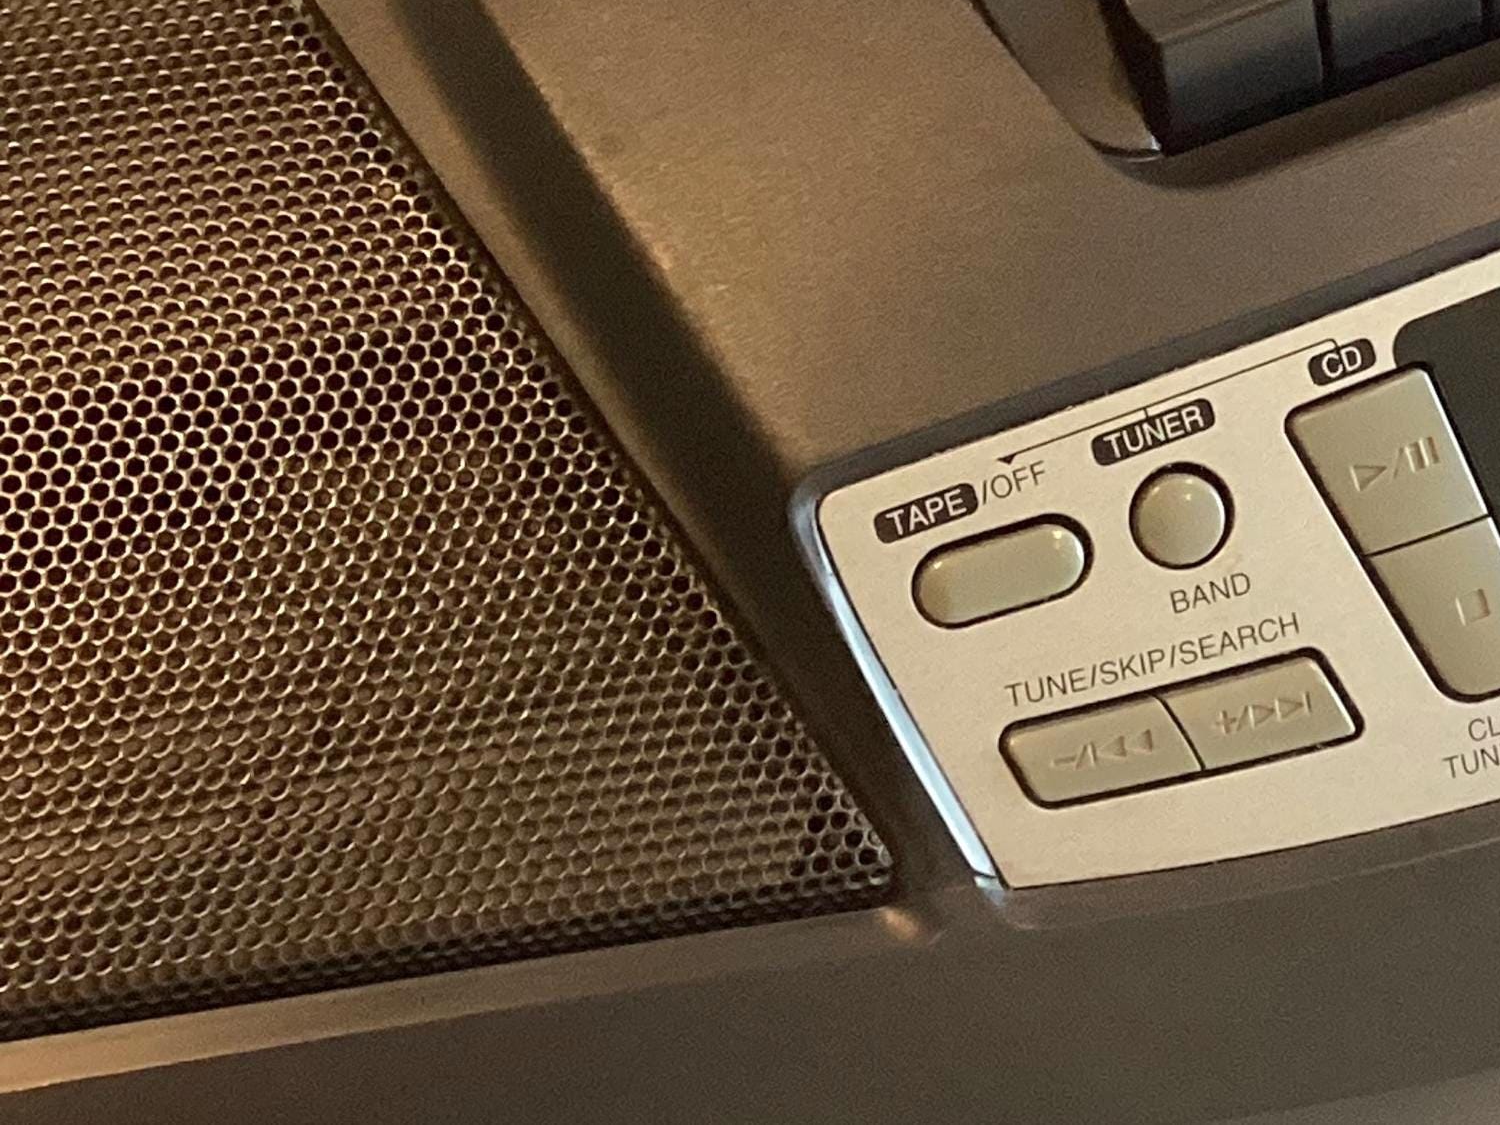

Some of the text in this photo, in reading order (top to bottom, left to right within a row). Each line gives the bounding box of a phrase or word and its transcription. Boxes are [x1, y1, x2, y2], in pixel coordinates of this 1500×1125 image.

[1320, 344, 1364, 380] CD
[1102, 405, 1205, 460] TUNER
[1168, 572, 1252, 615] BAND
[1005, 612, 1300, 708] TUNE/SKIP/SEARCH
